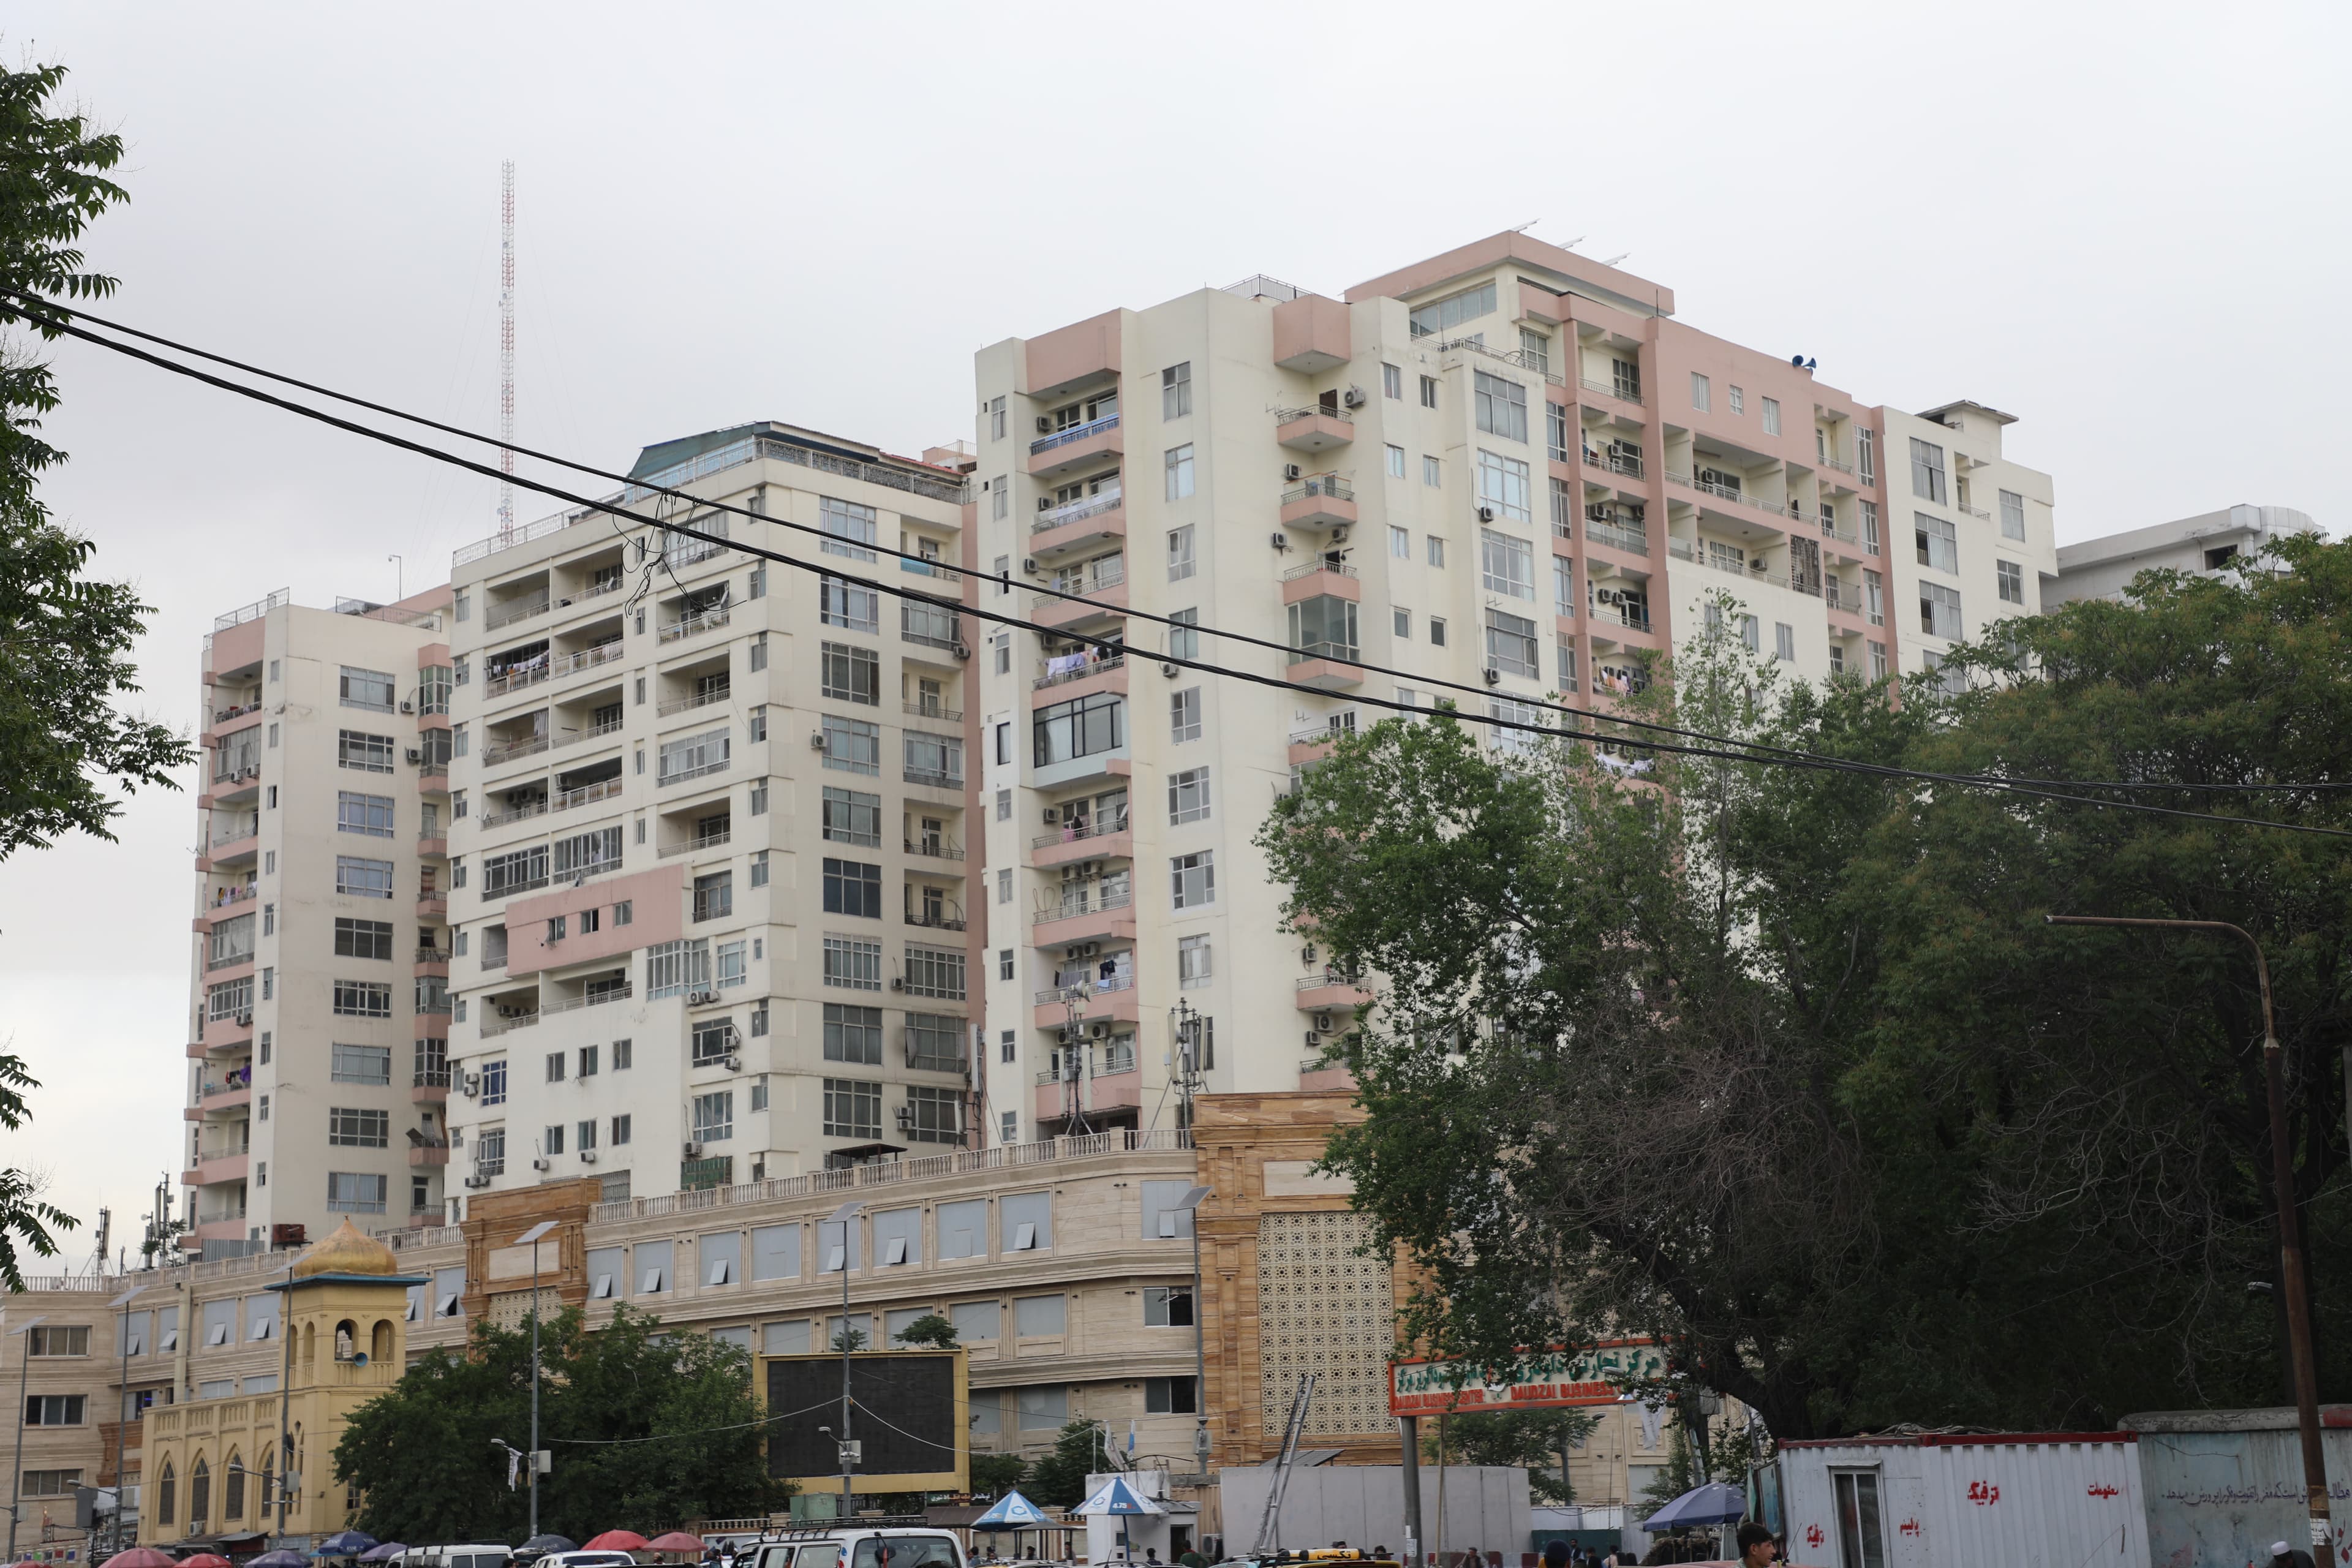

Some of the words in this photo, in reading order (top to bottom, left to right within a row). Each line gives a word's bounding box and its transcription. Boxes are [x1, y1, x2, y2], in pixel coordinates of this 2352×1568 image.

[1626, 1349, 1660, 1377] مرکز
[1510, 1384, 1557, 1400] DAUDZAI
[1560, 1381, 1614, 1398] BUSINESS
[1395, 1395, 1421, 1409] DAUDZAI
[1317, 1551, 1351, 1560] تکسی
